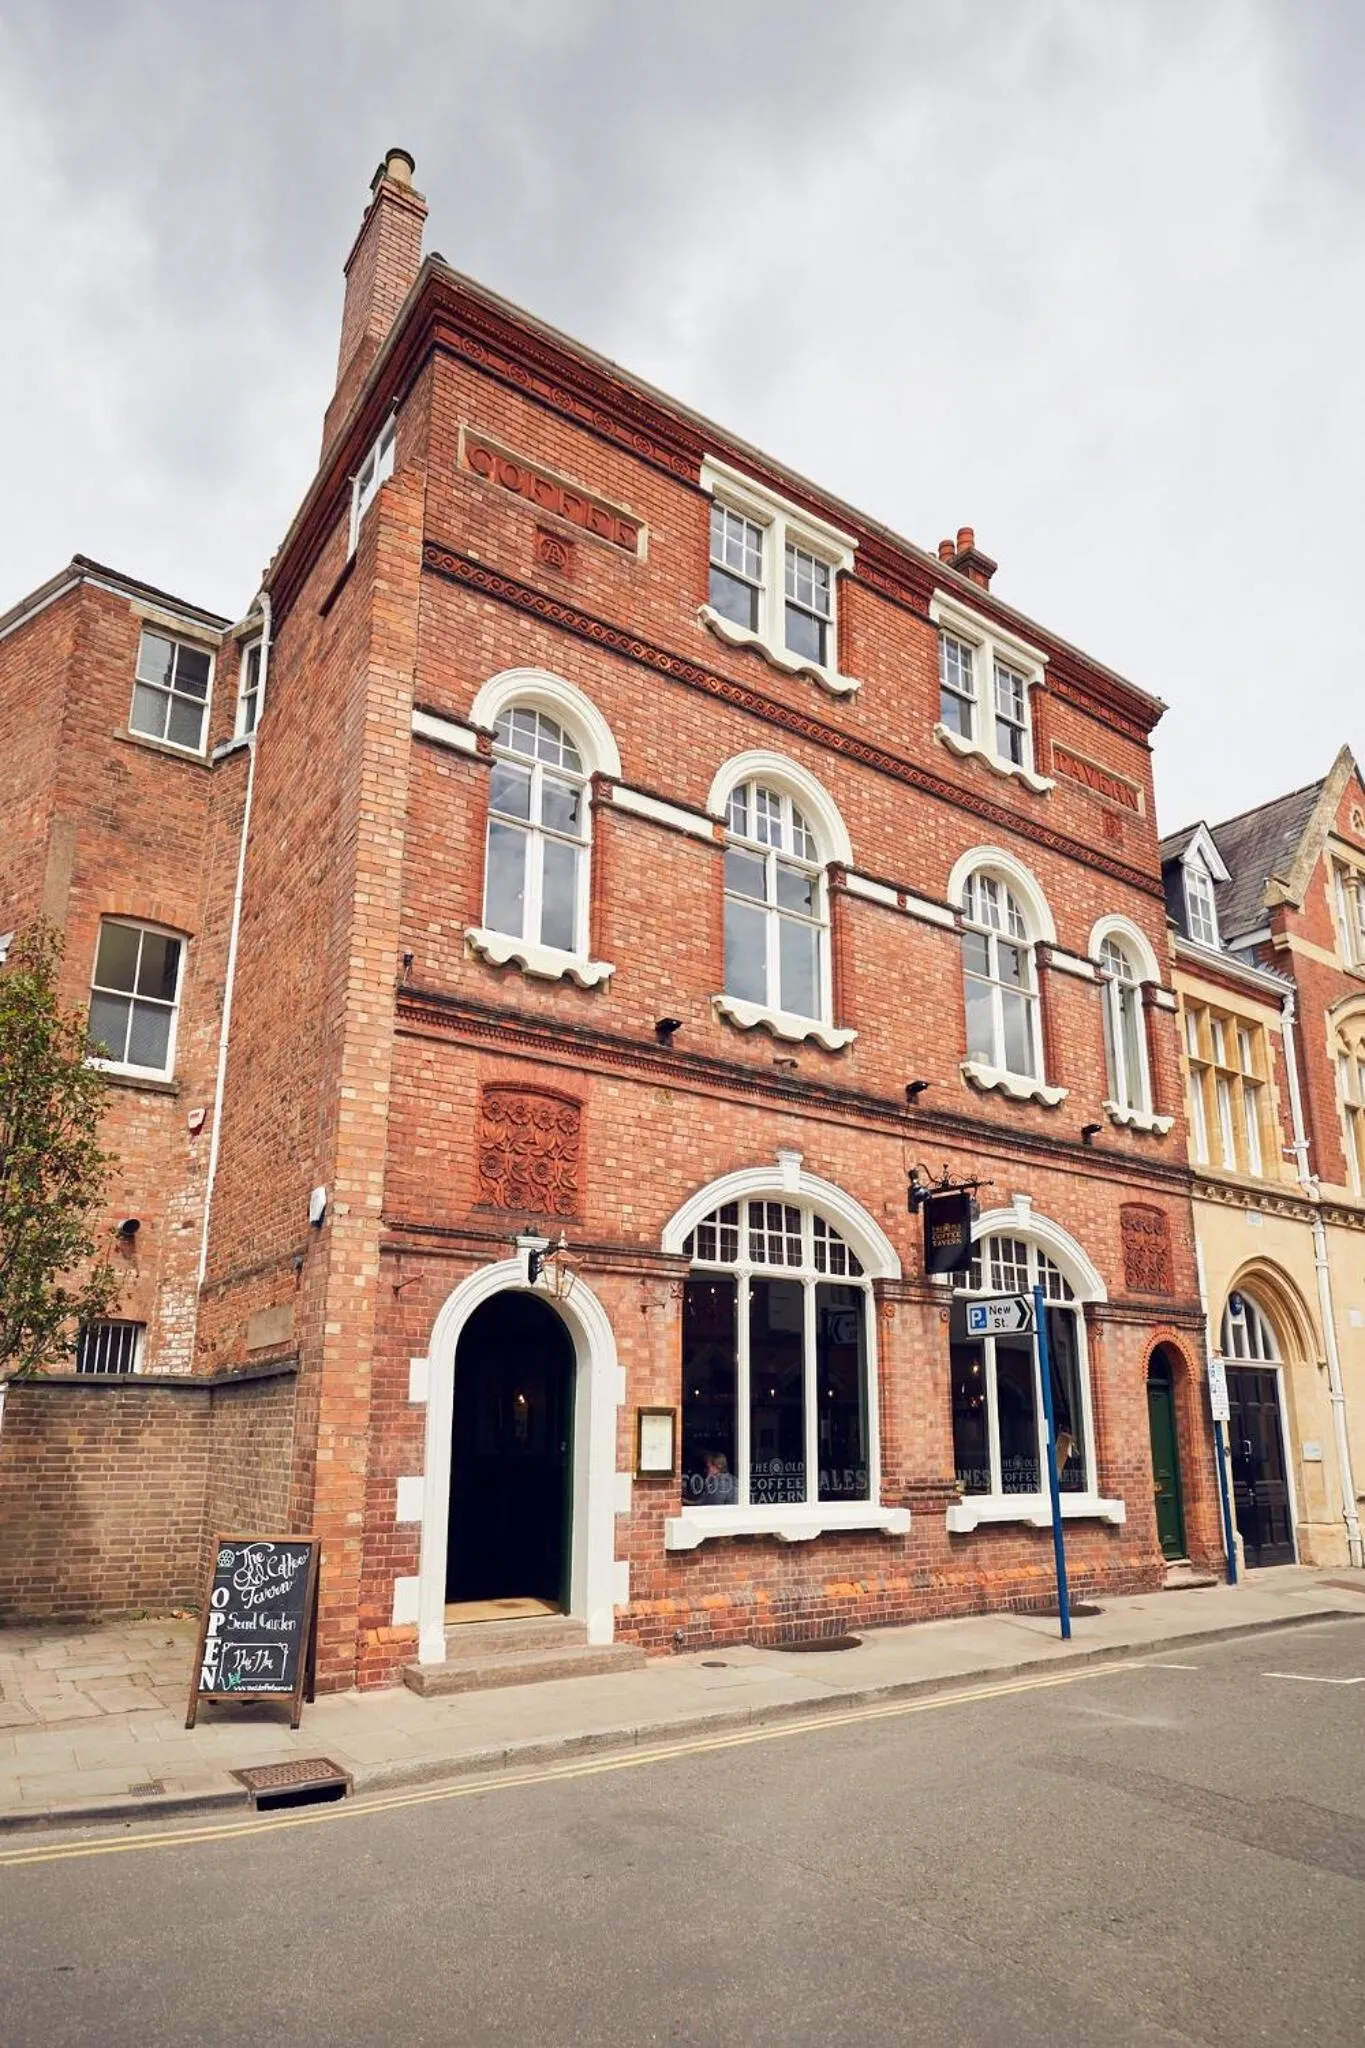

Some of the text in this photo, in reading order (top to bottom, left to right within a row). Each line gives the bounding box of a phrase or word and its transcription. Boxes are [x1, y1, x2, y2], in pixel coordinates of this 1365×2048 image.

[467, 447, 638, 554] COFFEE
[1054, 751, 1139, 811] TAVERN
[989, 1305, 1010, 1315] New
[750, 1462, 804, 1473] THE OLD
[1001, 1471, 1040, 1483] OFFEE
[750, 1477, 804, 1490] COFFEE
[818, 1469, 868, 1490] ALES
[957, 1469, 989, 1487] INES
[750, 1490, 805, 1504] TAVERN
[1002, 1483, 1041, 1494] AVERN
[236, 1543, 275, 1574] The
[233, 1548, 309, 1590] Old Coffee
[241, 1581, 296, 1609] Tavern
[199, 1587, 230, 1690] OPEN
